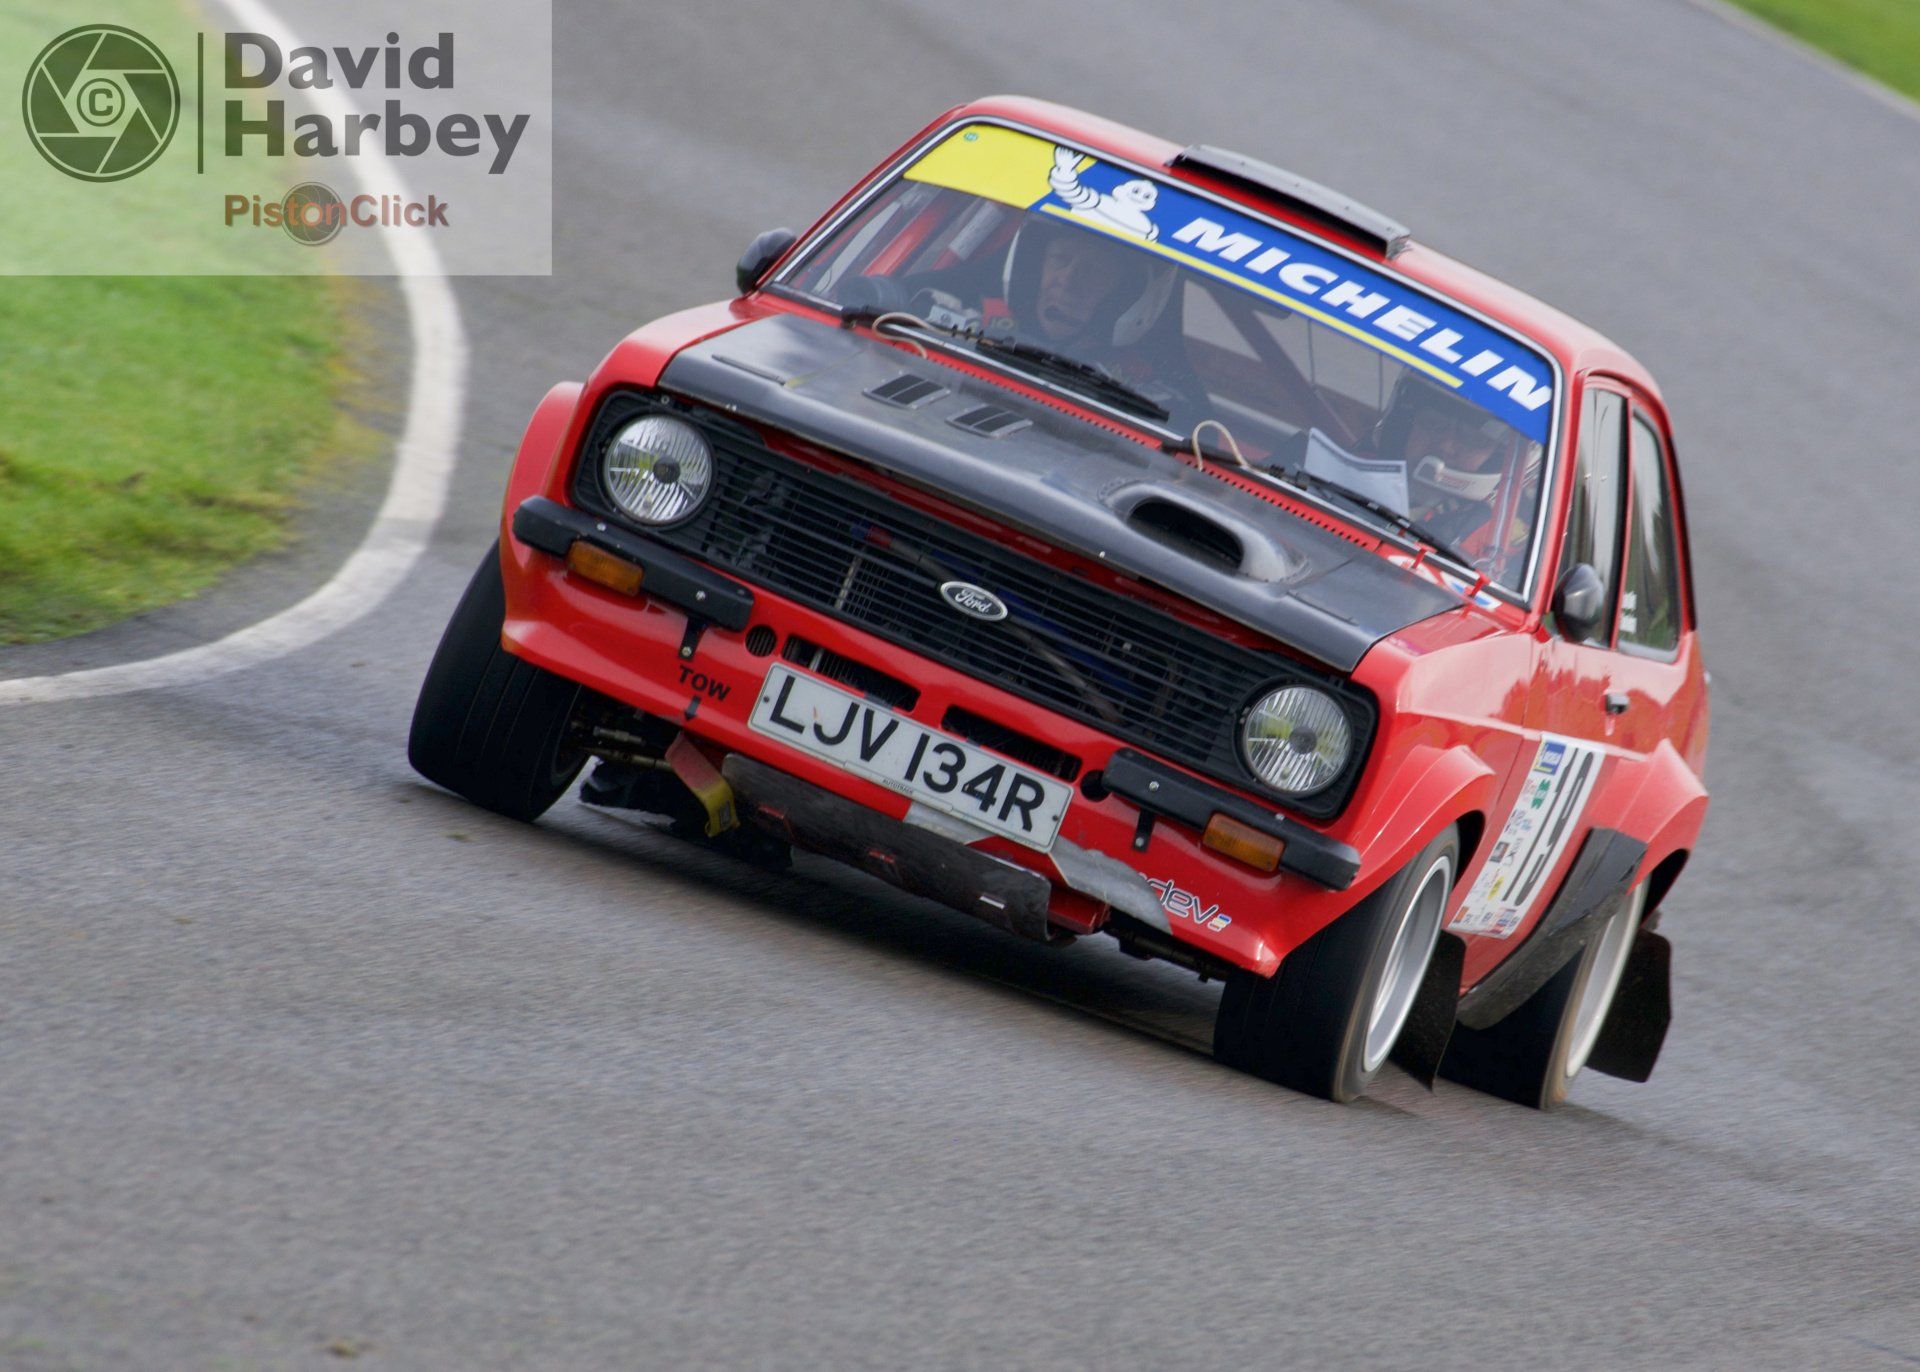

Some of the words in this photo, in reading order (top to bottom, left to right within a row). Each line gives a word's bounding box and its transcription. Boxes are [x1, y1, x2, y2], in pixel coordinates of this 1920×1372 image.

[1171, 217, 1553, 412] MICHELIN
[955, 588, 992, 613] Ford
[679, 664, 731, 702] TOW
[769, 675, 900, 763] LJV
[904, 733, 1046, 832] 134R
